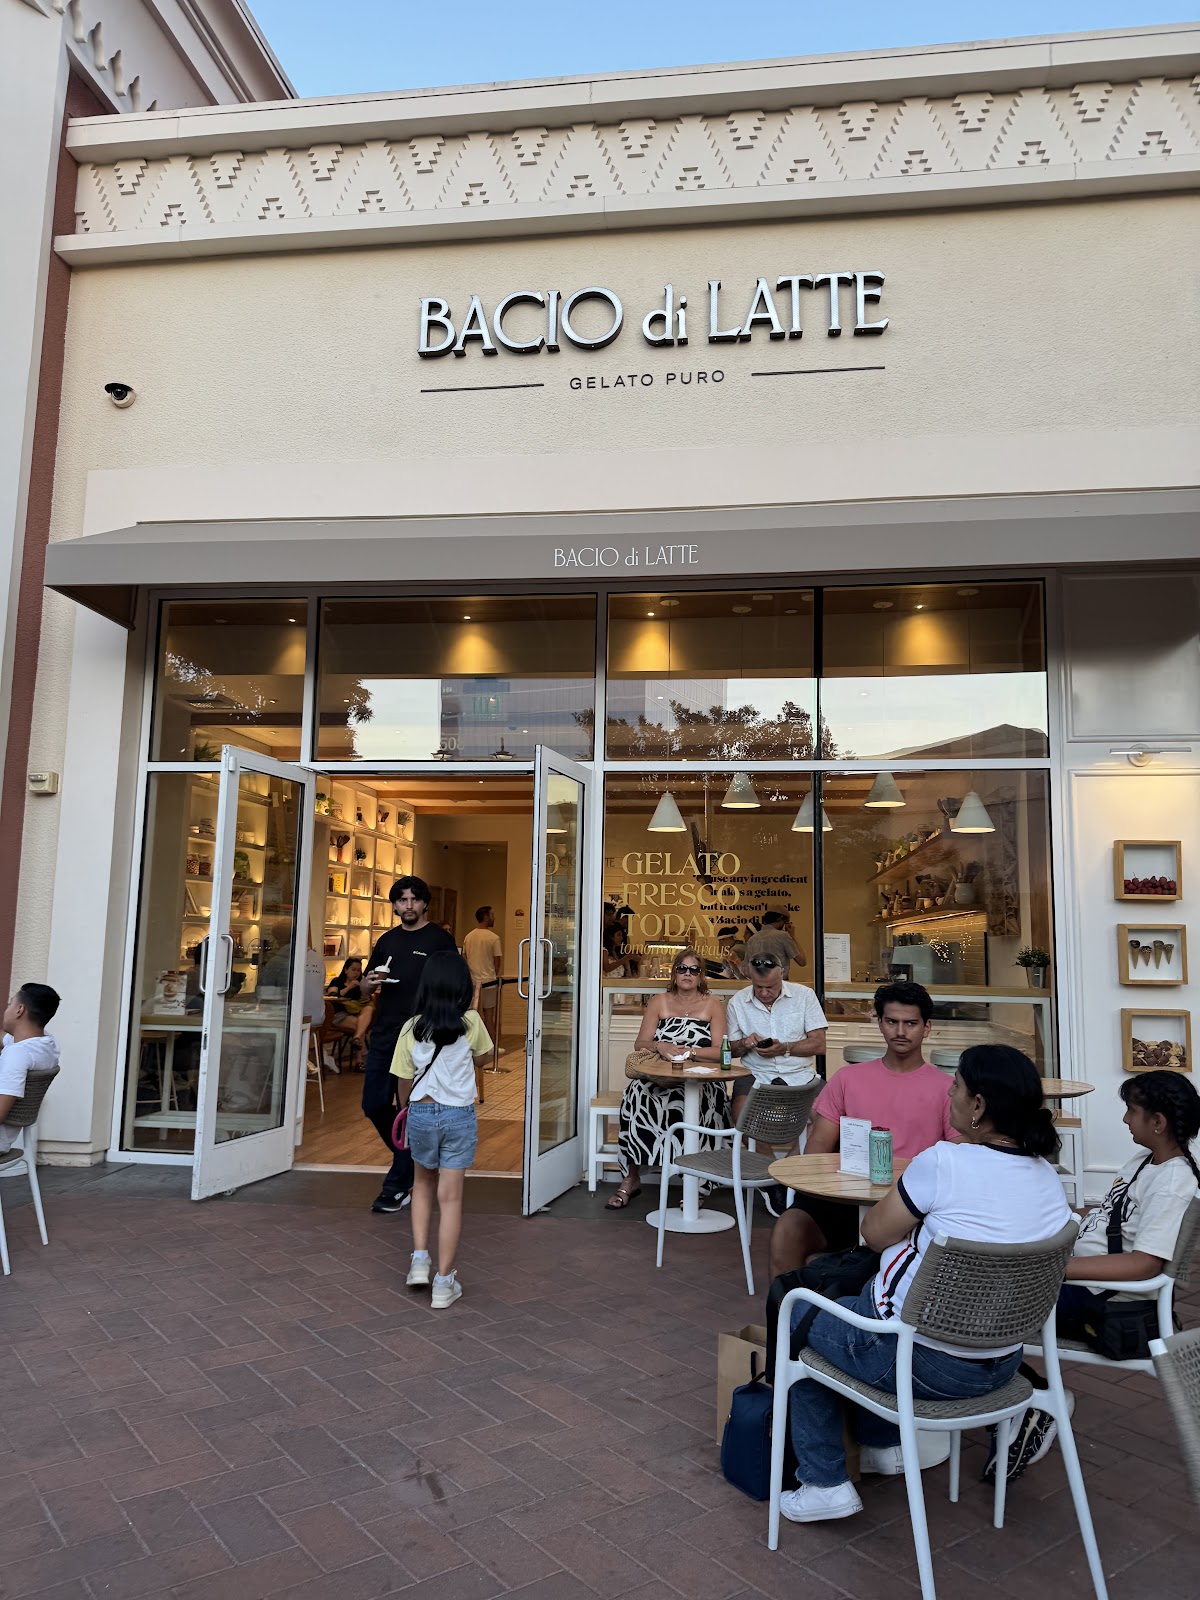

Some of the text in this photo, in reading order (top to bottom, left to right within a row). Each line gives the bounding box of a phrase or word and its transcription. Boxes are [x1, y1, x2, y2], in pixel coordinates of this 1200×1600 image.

[417, 269, 890, 358] BACIO di LATTE
[569, 369, 726, 390] GELATO PURO
[554, 544, 699, 567] BACIO di LATTE
[621, 852, 741, 876] GELATO
[750, 873, 808, 885] ingredient
[621, 882, 741, 908] FRESCO
[620, 913, 723, 938] TODAY
